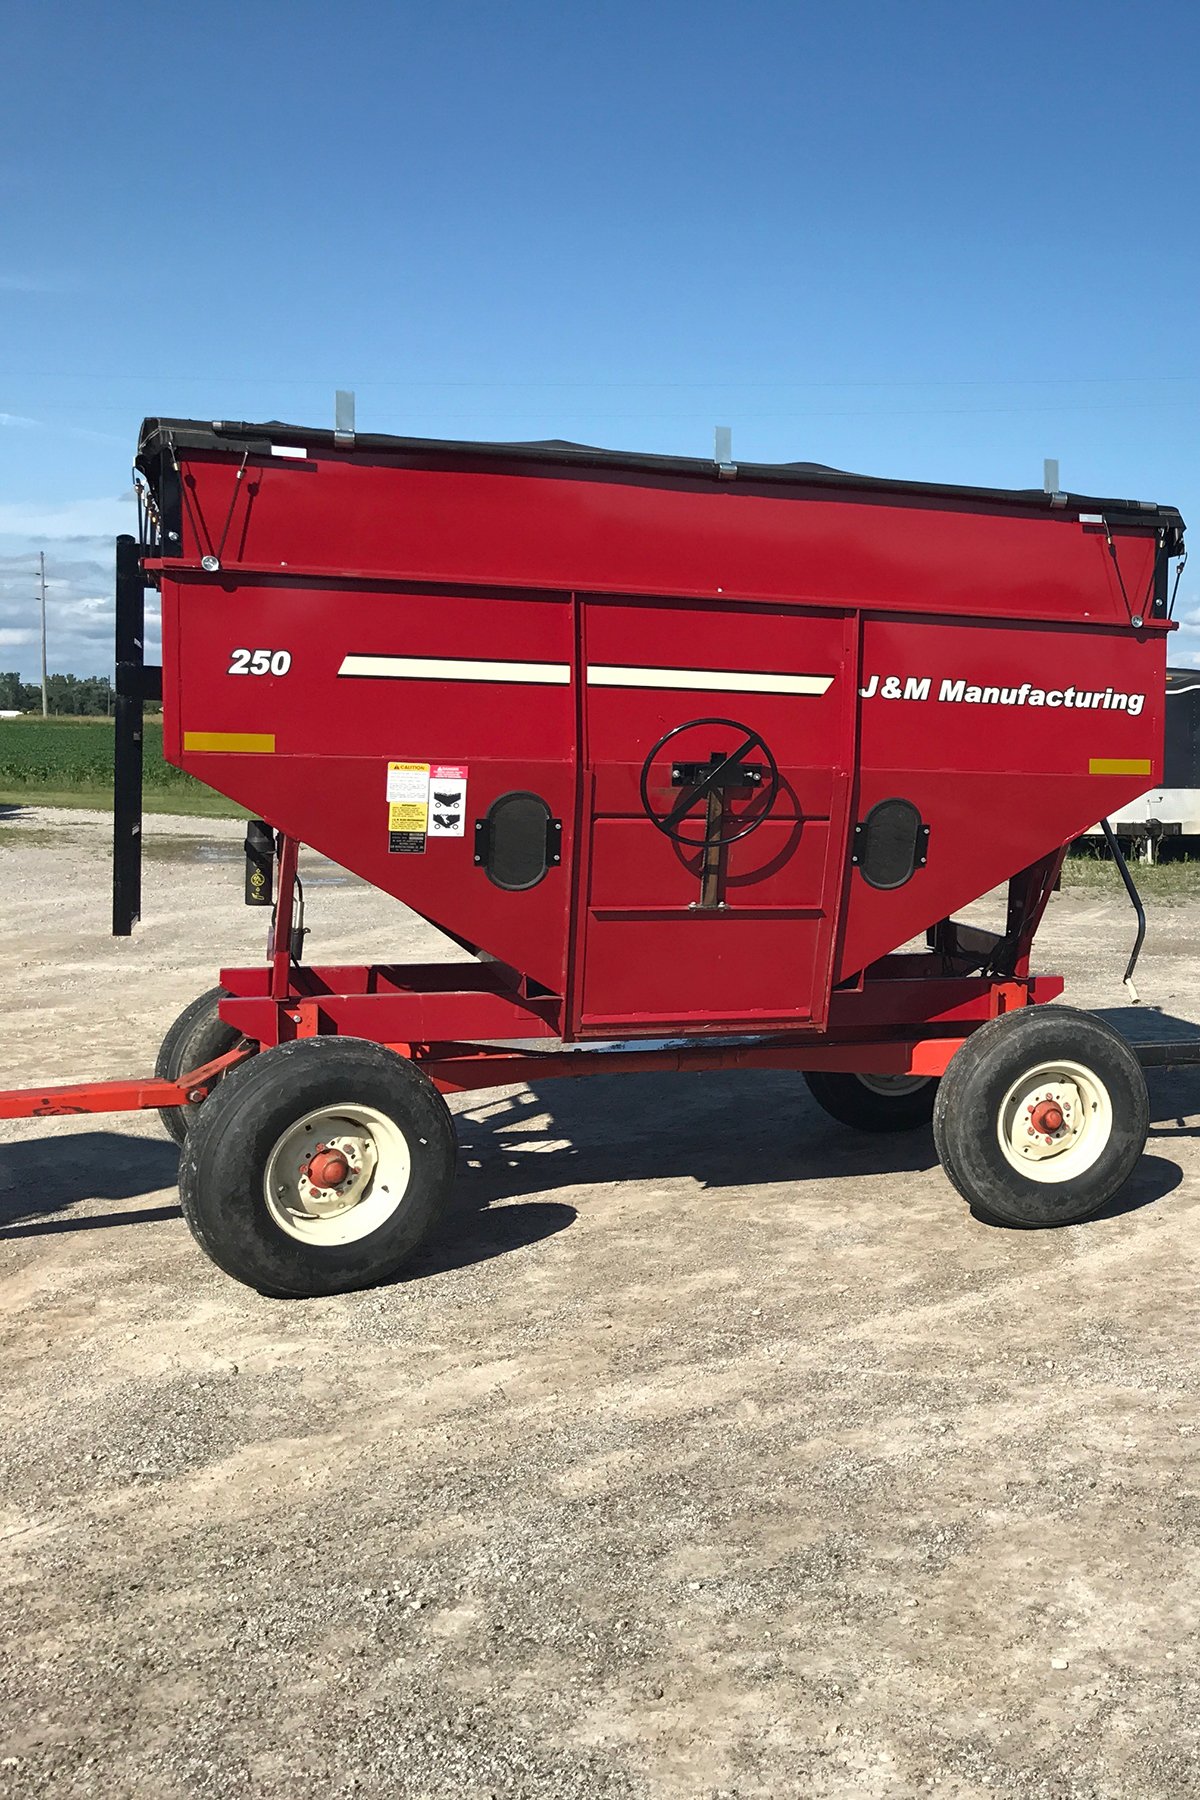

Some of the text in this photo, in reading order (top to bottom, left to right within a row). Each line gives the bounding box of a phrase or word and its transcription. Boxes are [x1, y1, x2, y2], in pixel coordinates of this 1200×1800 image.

[227, 648, 292, 677] 250
[860, 675, 1145, 716] J&M Manufacturing
